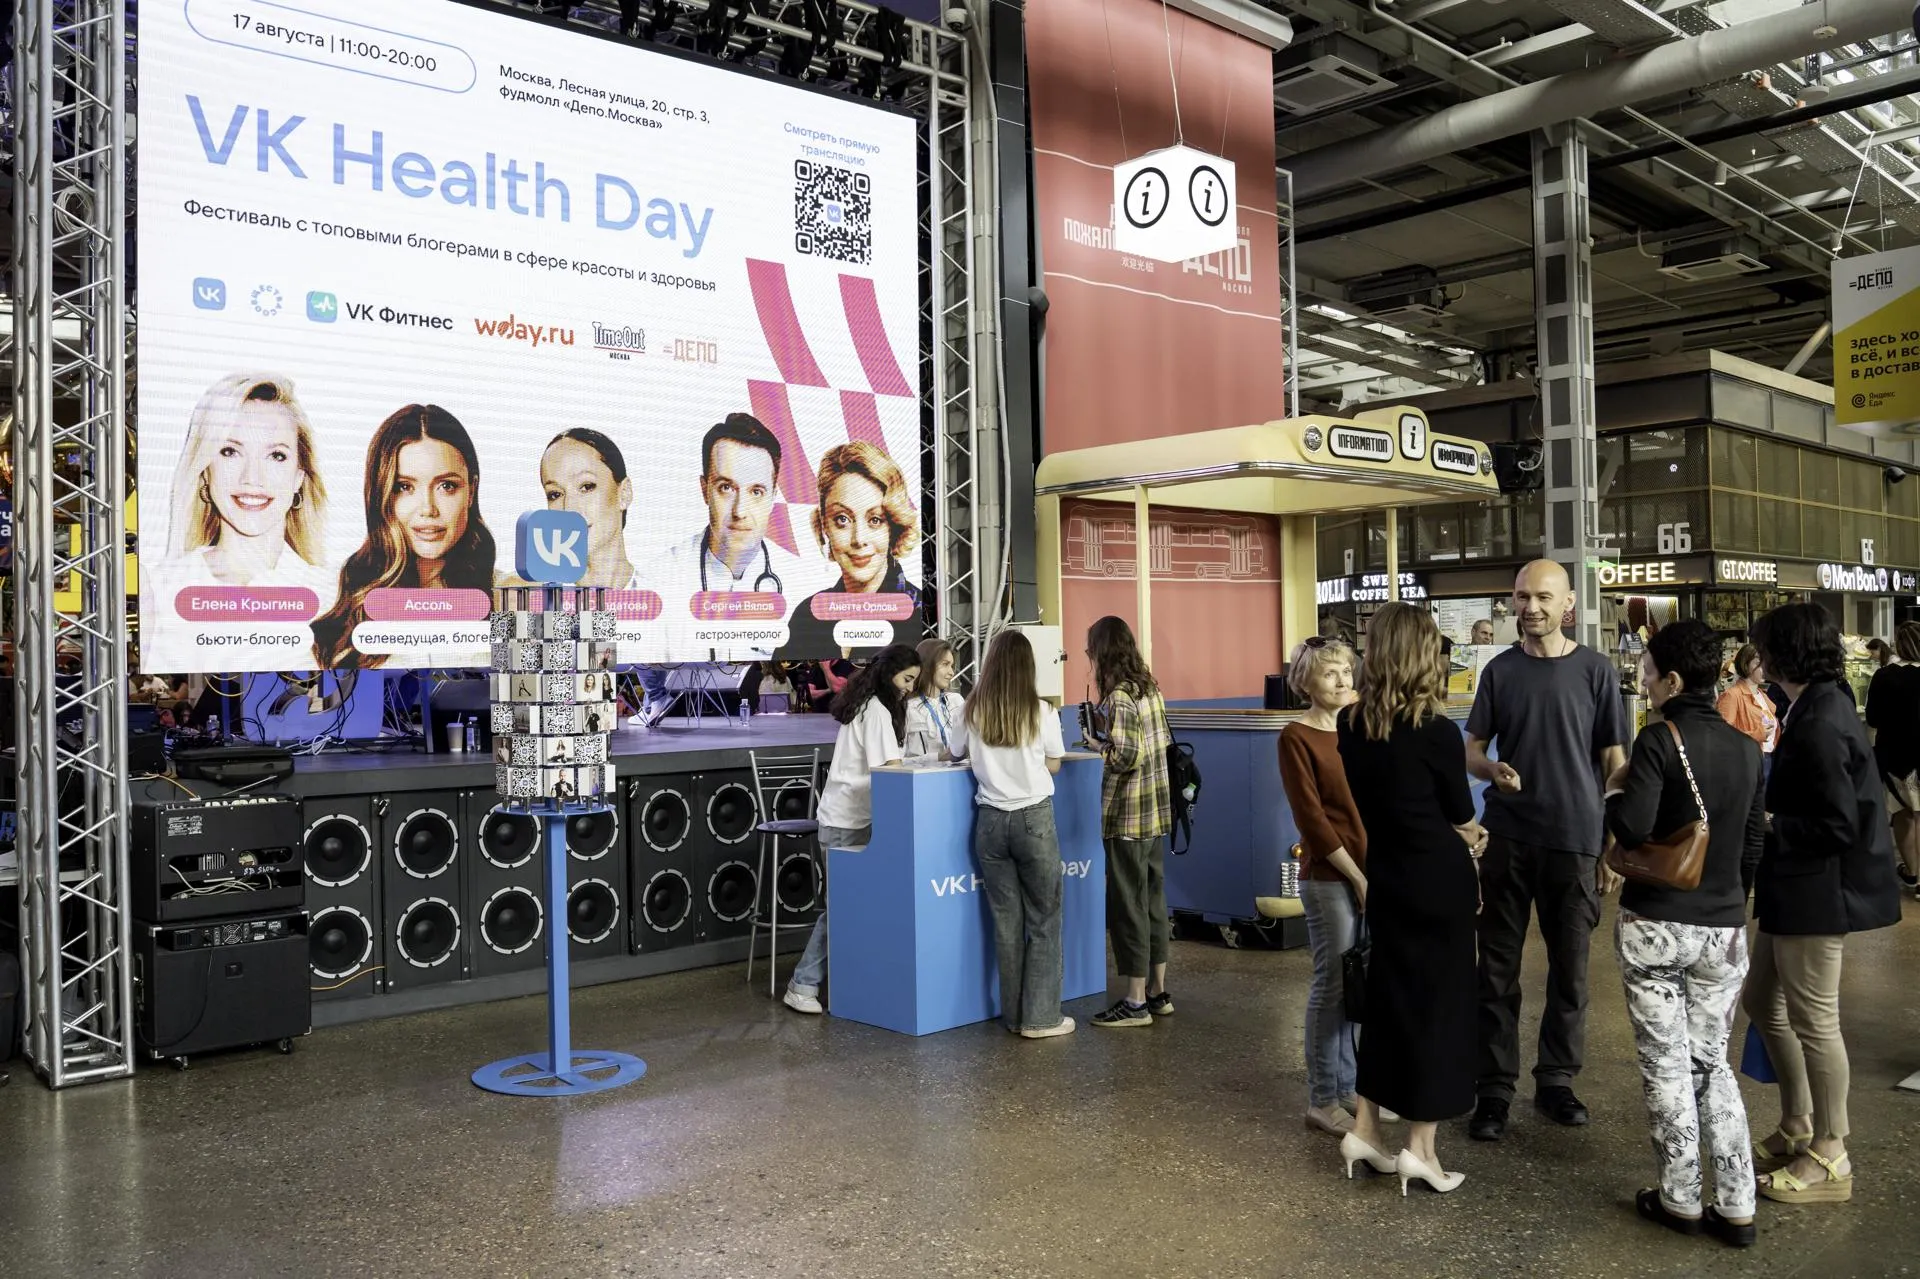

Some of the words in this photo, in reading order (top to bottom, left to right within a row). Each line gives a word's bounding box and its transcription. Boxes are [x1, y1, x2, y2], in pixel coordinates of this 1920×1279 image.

[232, 13, 251, 30] 17
[255, 21, 325, 48] августа
[338, 38, 437, 73] 11:00-20:00
[499, 64, 555, 90] Москва,
[558, 75, 606, 100] Лесная
[607, 89, 649, 111] улица,
[651, 98, 671, 115] 20,
[672, 106, 697, 124] стр.
[699, 110, 711, 124] 3,
[499, 84, 560, 110] фудмолл
[563, 97, 664, 130] «Депо.Москва»
[783, 121, 837, 144] Смотреть
[838, 137, 881, 154] прямую
[799, 144, 866, 167] трансляцию
[184, 93, 309, 180] VK
[332, 122, 571, 223] Health
[595, 172, 714, 259] Day
[1063, 217, 1116, 250] ПОЖАЛ
[183, 199, 292, 230] Фестиваль
[296, 219, 308, 232] с
[311, 221, 403, 247] топовыми
[406, 233, 499, 260] блогерами
[503, 250, 513, 262] в
[516, 250, 569, 271] сфере
[571, 260, 635, 282] красоты
[638, 270, 649, 282] и
[650, 272, 717, 293] здоровья
[345, 302, 374, 322] VK
[379, 306, 454, 331] Фитнес
[1850, 334, 1897, 350] здесь
[1900, 330, 1920, 342] хо
[609, 352, 631, 361] МОСКВА
[1850, 348, 1883, 364] всё,
[1887, 349, 1897, 359] и
[1901, 346, 1920, 357] вс
[1851, 369, 1860, 379] в
[1863, 361, 1920, 380] достав
[1868, 391, 1896, 400] Яндекс
[1337, 433, 1388, 453] INFORMATION
[532, 527, 581, 568] VK
[1657, 522, 1692, 555] 66
[1361, 572, 1416, 587] SWETS
[1599, 561, 1676, 585] OFFEE
[1722, 559, 1777, 583] GT.COFFEE
[1351, 588, 1390, 601] COFFE
[1400, 586, 1427, 599] TEA
[191, 597, 238, 611] Елена
[241, 598, 305, 613] Крыгина
[404, 599, 453, 611] Ассоль
[703, 600, 742, 613] Сергей
[743, 601, 775, 612] Вялов
[828, 601, 862, 612] Анетта
[862, 601, 898, 613] Орлова
[195, 632, 302, 647] бьюти-блогер
[358, 633, 449, 647] телеведущая,
[695, 630, 782, 642] гастроэнтеролог
[843, 630, 885, 639] психолог
[930, 874, 967, 897] VK
